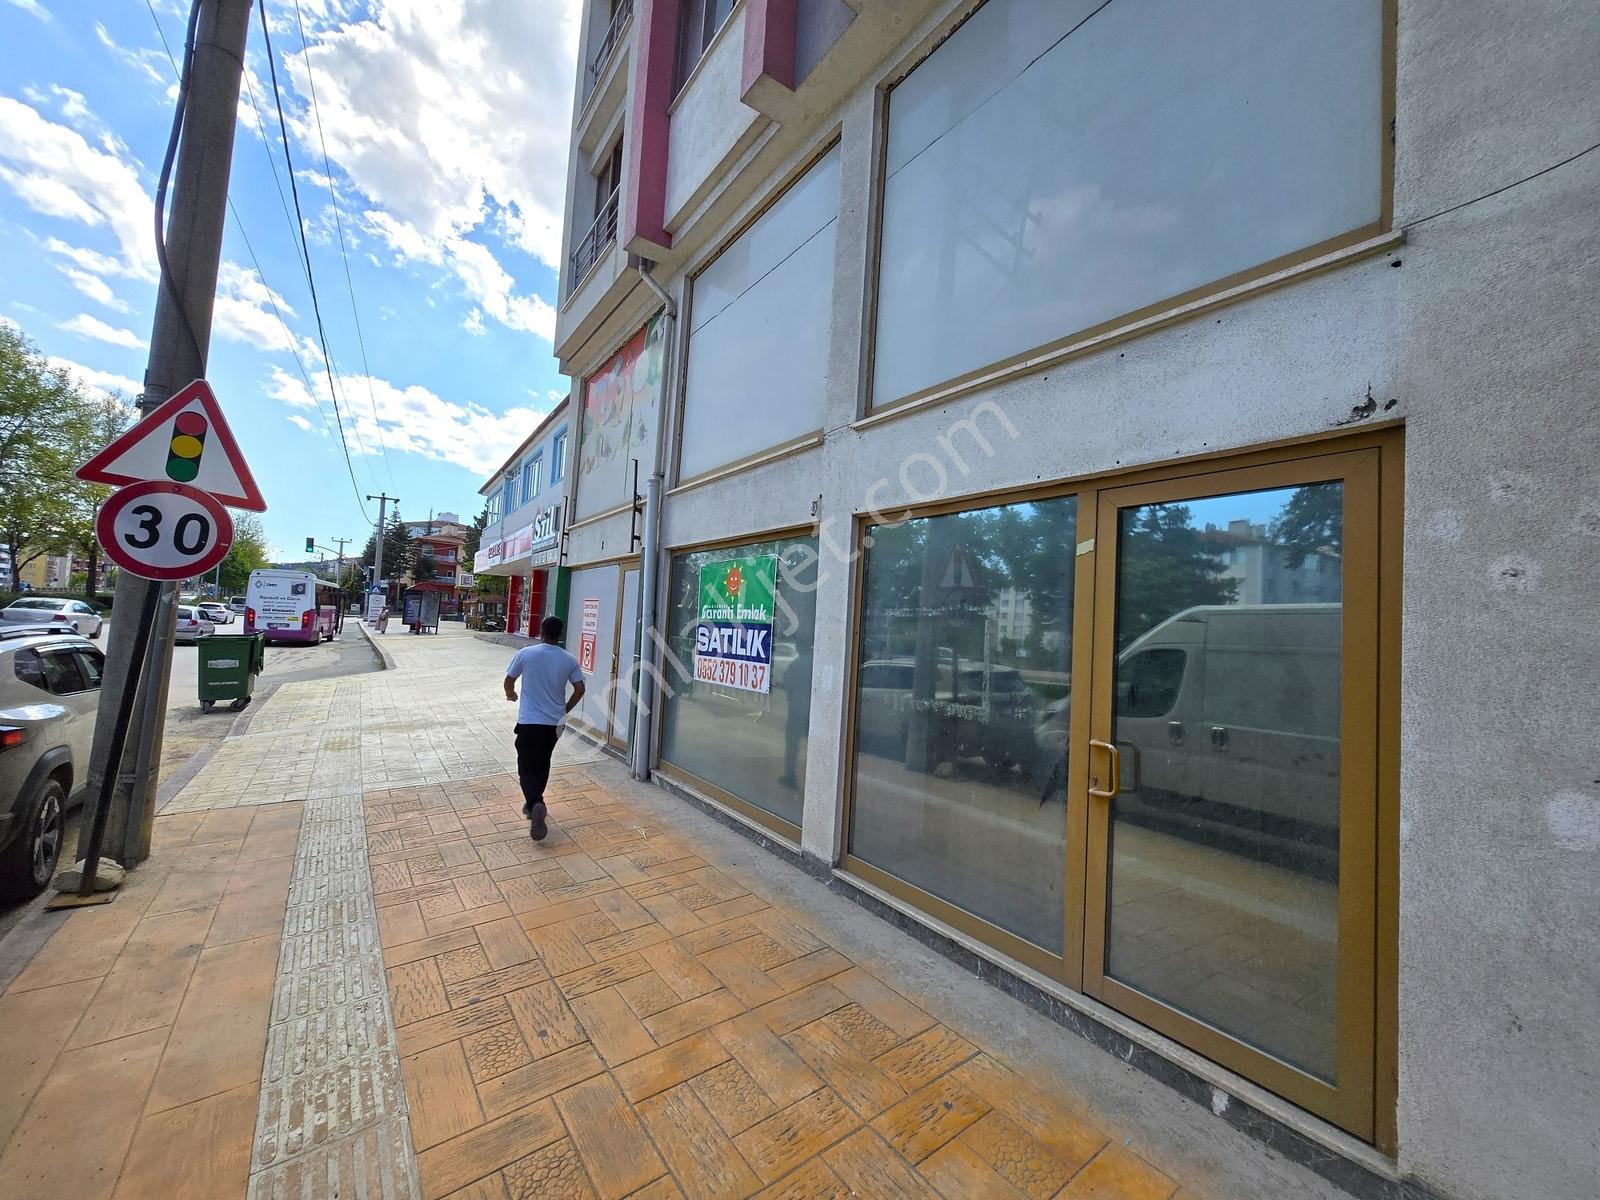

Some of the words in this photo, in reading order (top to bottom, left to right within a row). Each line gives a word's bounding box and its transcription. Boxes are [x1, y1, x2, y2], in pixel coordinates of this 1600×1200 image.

[124, 504, 211, 556] 30
[702, 604, 734, 620] Garanti
[736, 603, 767, 621] Emlak
[697, 626, 768, 658] SATILIK
[697, 659, 717, 681] 0552
[719, 661, 736, 685] 379
[739, 664, 749, 687] 10
[751, 666, 766, 690] 37
